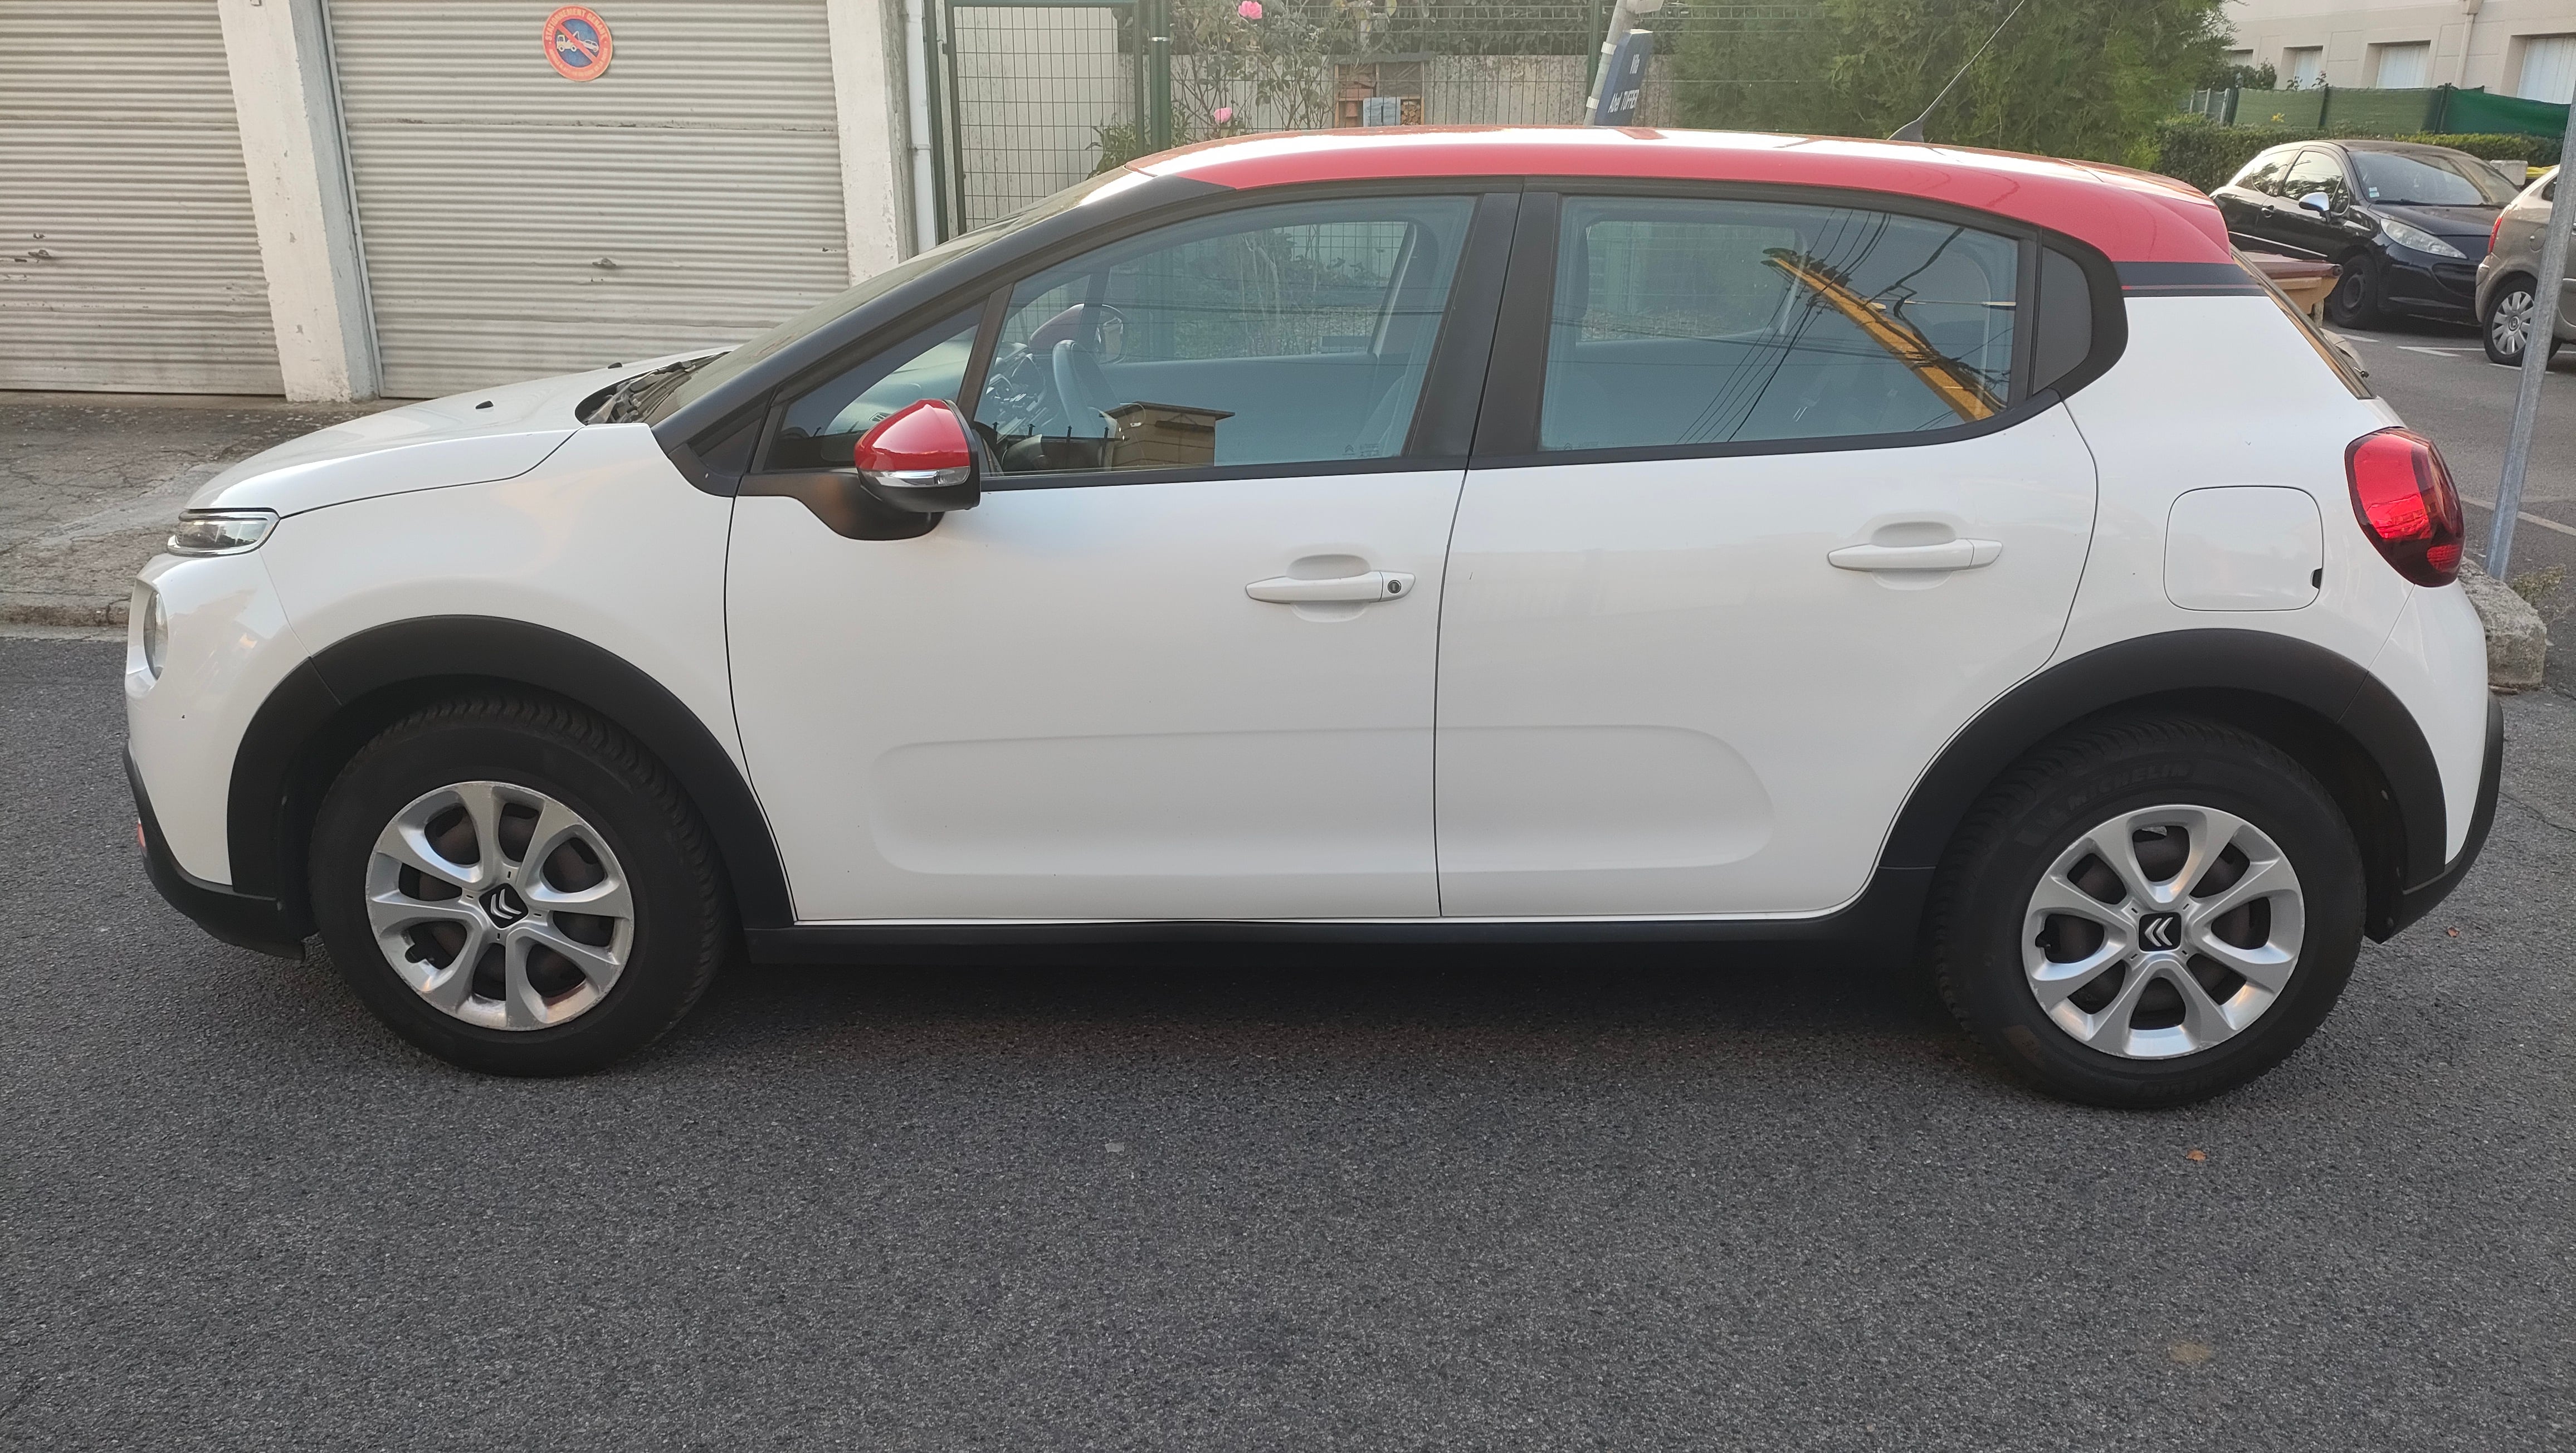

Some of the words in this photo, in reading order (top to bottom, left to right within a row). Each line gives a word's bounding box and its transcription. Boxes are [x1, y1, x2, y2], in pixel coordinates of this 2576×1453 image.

[546, 9, 586, 41] STATIONNEMENT
[1608, 92, 1623, 113] Abel
[2067, 762, 2191, 810] MICHELIN
